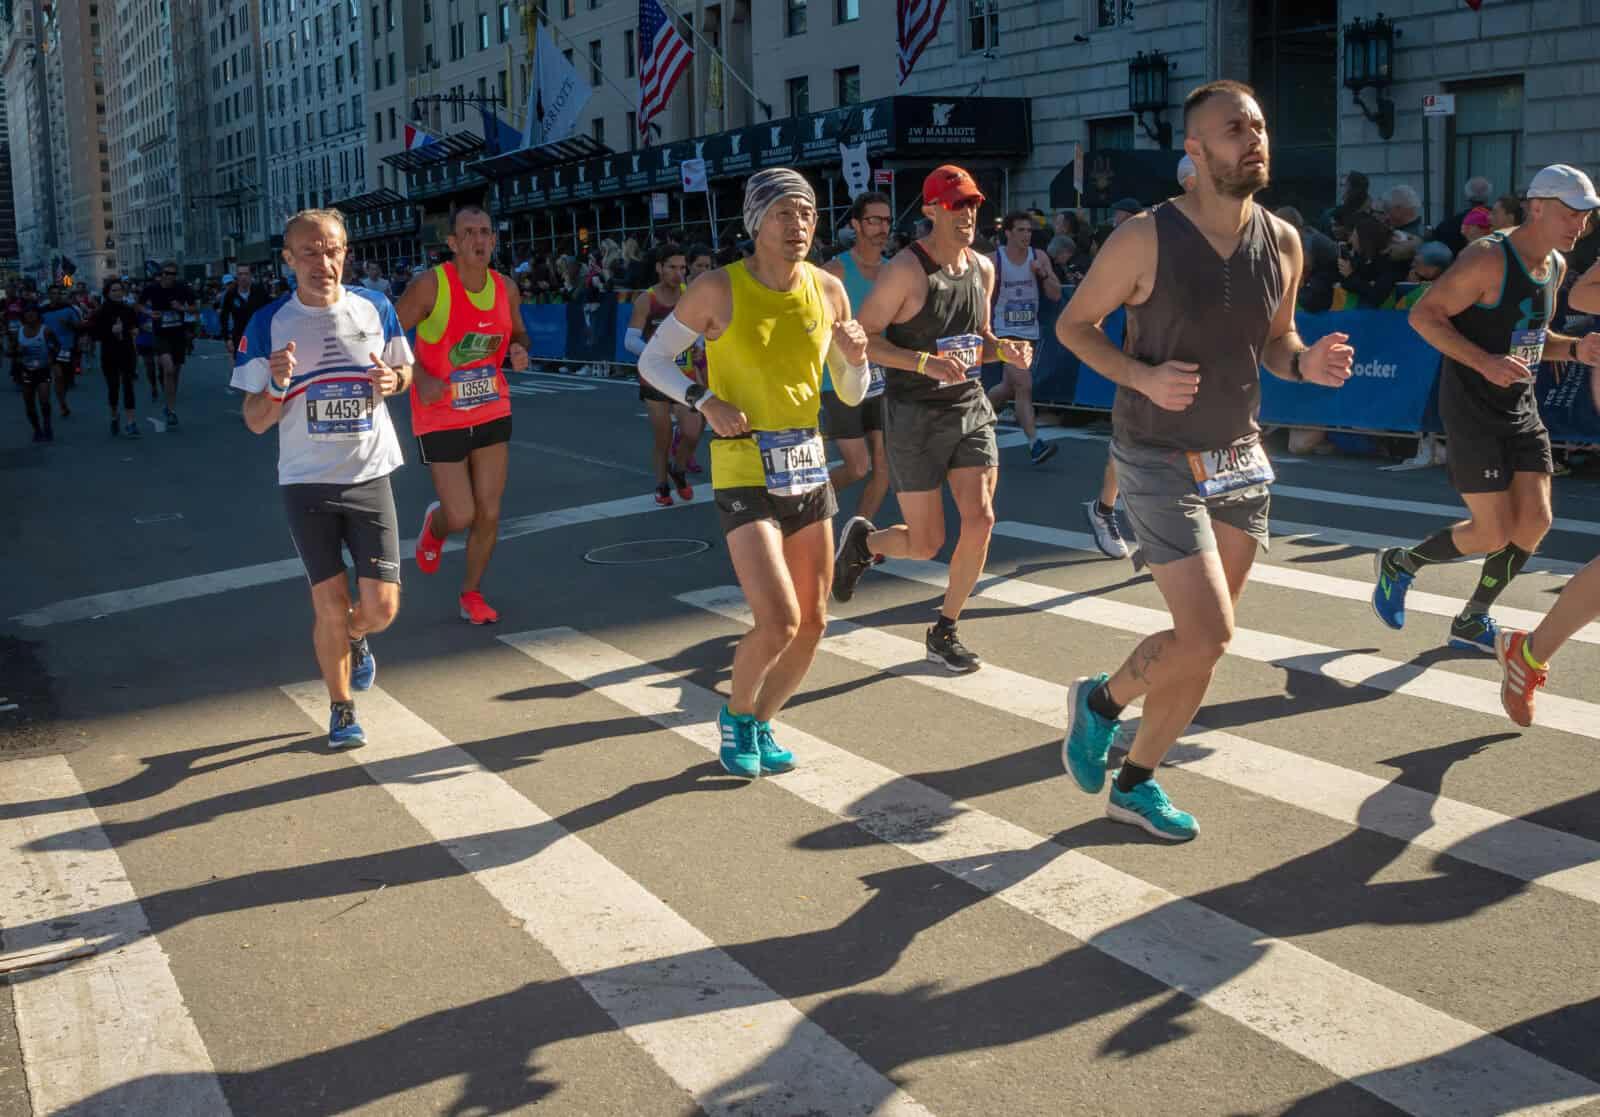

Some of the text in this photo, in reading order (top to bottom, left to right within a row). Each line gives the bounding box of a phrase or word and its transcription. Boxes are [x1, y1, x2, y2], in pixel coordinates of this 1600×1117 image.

[926, 127, 976, 137] MARRIOTT
[1352, 359, 1398, 378] ocker
[462, 379, 490, 397] 13552
[324, 399, 361, 420] 4453
[780, 445, 813, 470] 7644
